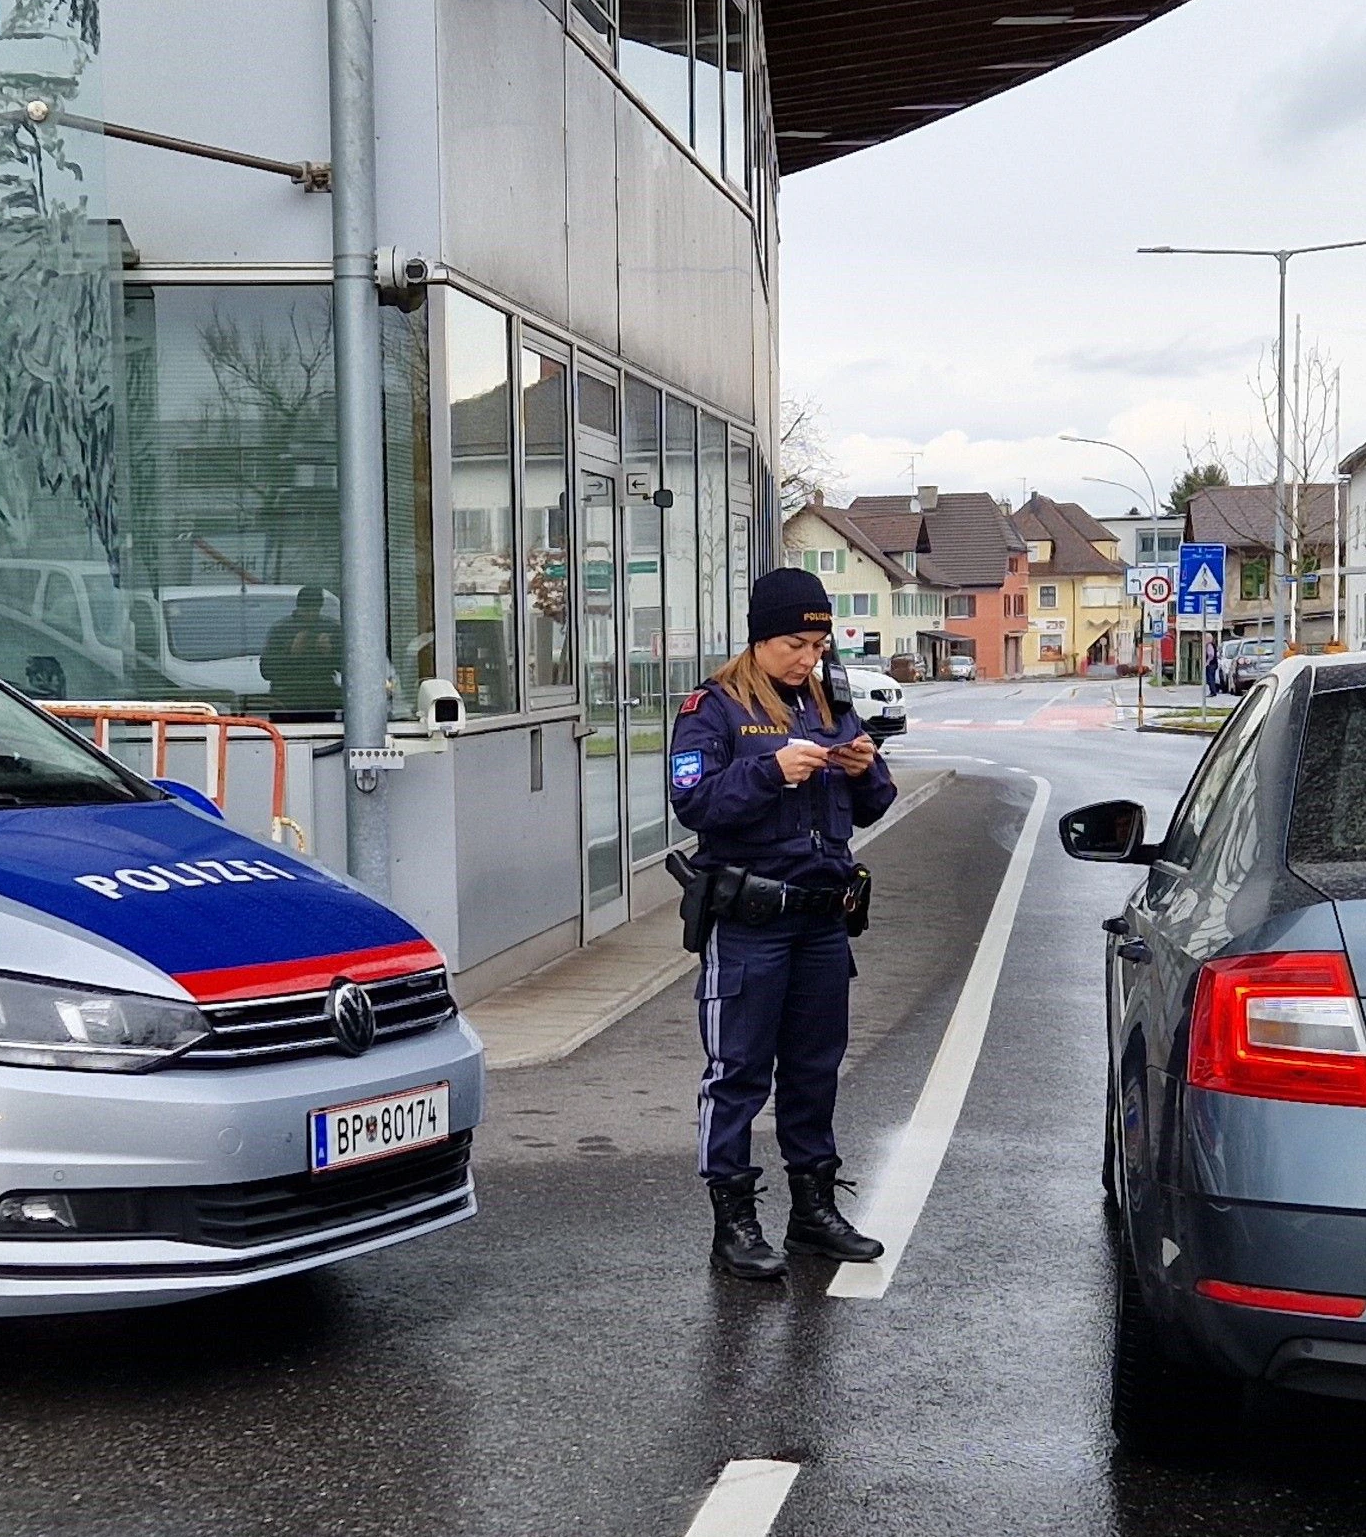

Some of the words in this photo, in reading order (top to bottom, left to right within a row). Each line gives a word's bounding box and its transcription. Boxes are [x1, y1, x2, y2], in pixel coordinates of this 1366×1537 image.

[1152, 583, 1165, 596] 50
[73, 860, 298, 900] POLIZEI
[337, 1115, 363, 1155] BP
[381, 1097, 437, 1144] 80174
